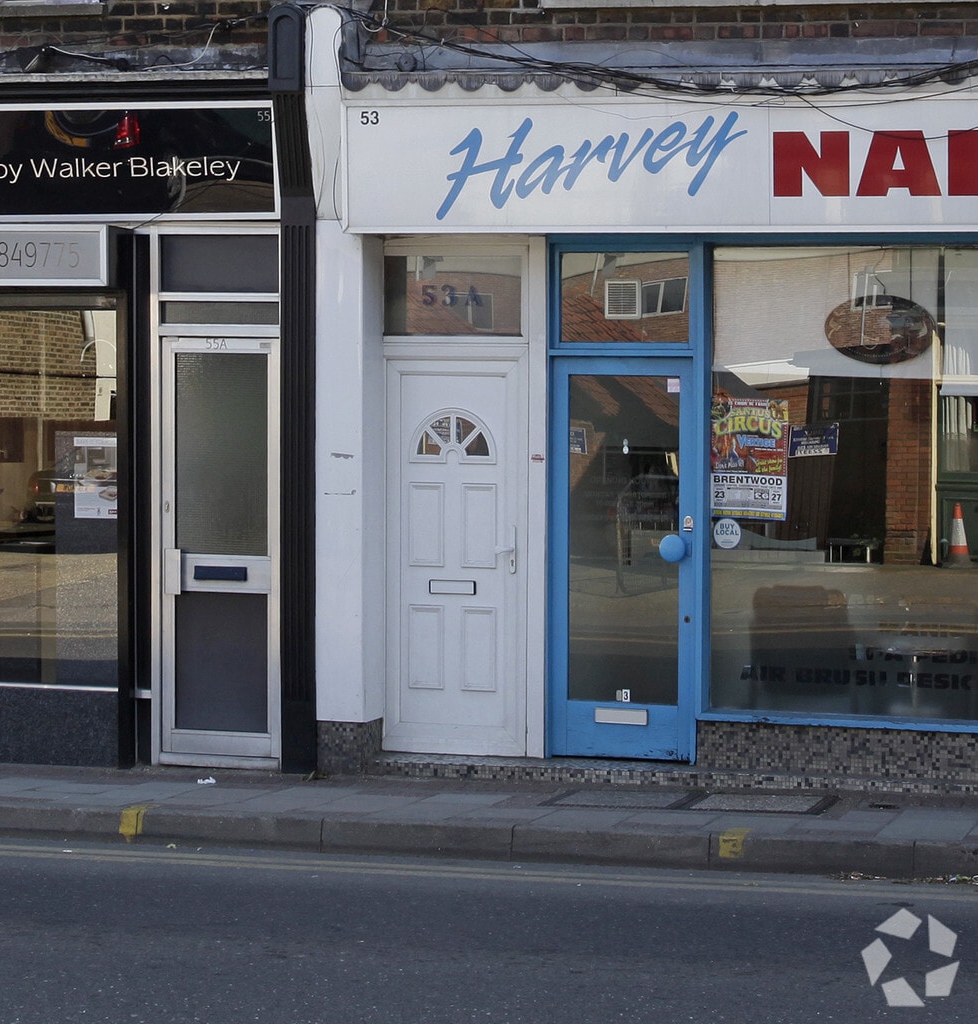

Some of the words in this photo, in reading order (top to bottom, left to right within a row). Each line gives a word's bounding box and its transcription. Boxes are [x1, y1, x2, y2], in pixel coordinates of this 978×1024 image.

[257, 111, 271, 122] 55
[360, 111, 379, 125] 53
[30, 157, 121, 179] Walker
[129, 157, 241, 181] Blakeley
[435, 111, 748, 221] Harvey
[421, 284, 483, 306] 53A
[205, 338, 228, 350] 55A
[715, 416, 782, 440] CIRCUS
[713, 475, 783, 486] BRENTWOOD
